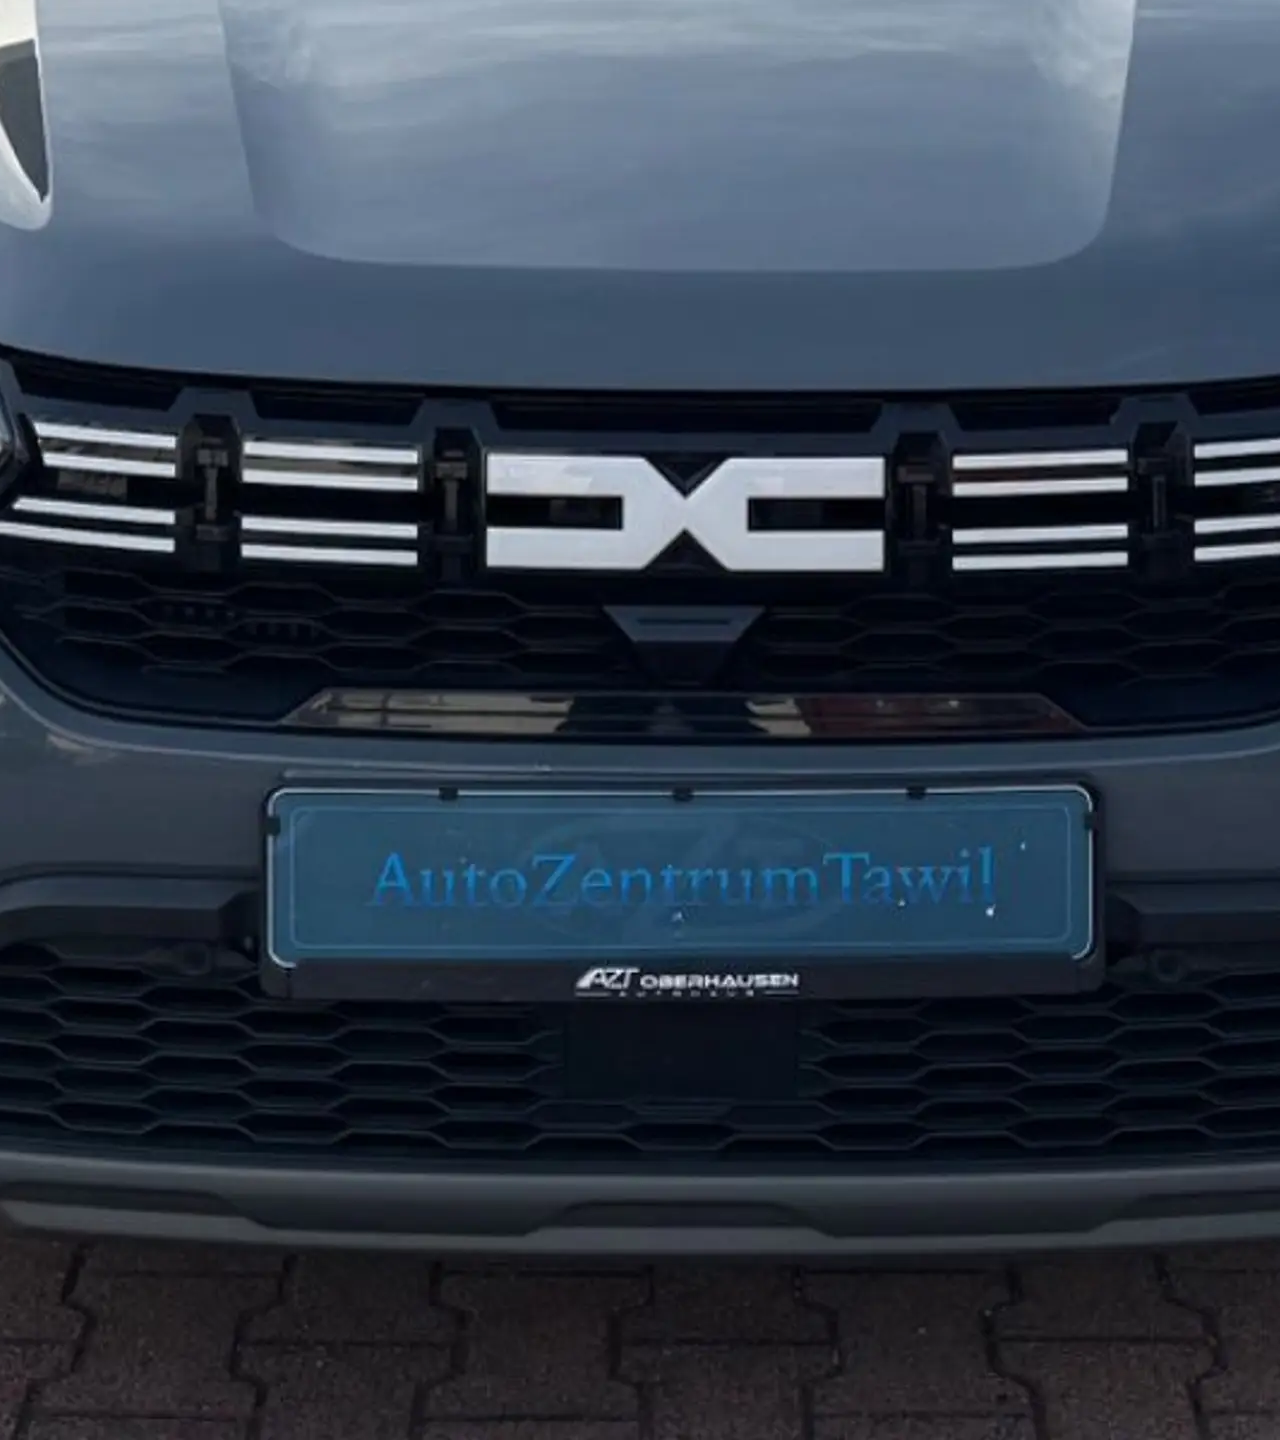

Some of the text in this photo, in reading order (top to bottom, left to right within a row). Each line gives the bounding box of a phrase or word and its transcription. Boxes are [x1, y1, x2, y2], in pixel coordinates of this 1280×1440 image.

[368, 847, 996, 907] AutoZentrumTawil
[575, 967, 799, 989] AZT OBERHAUSEN
